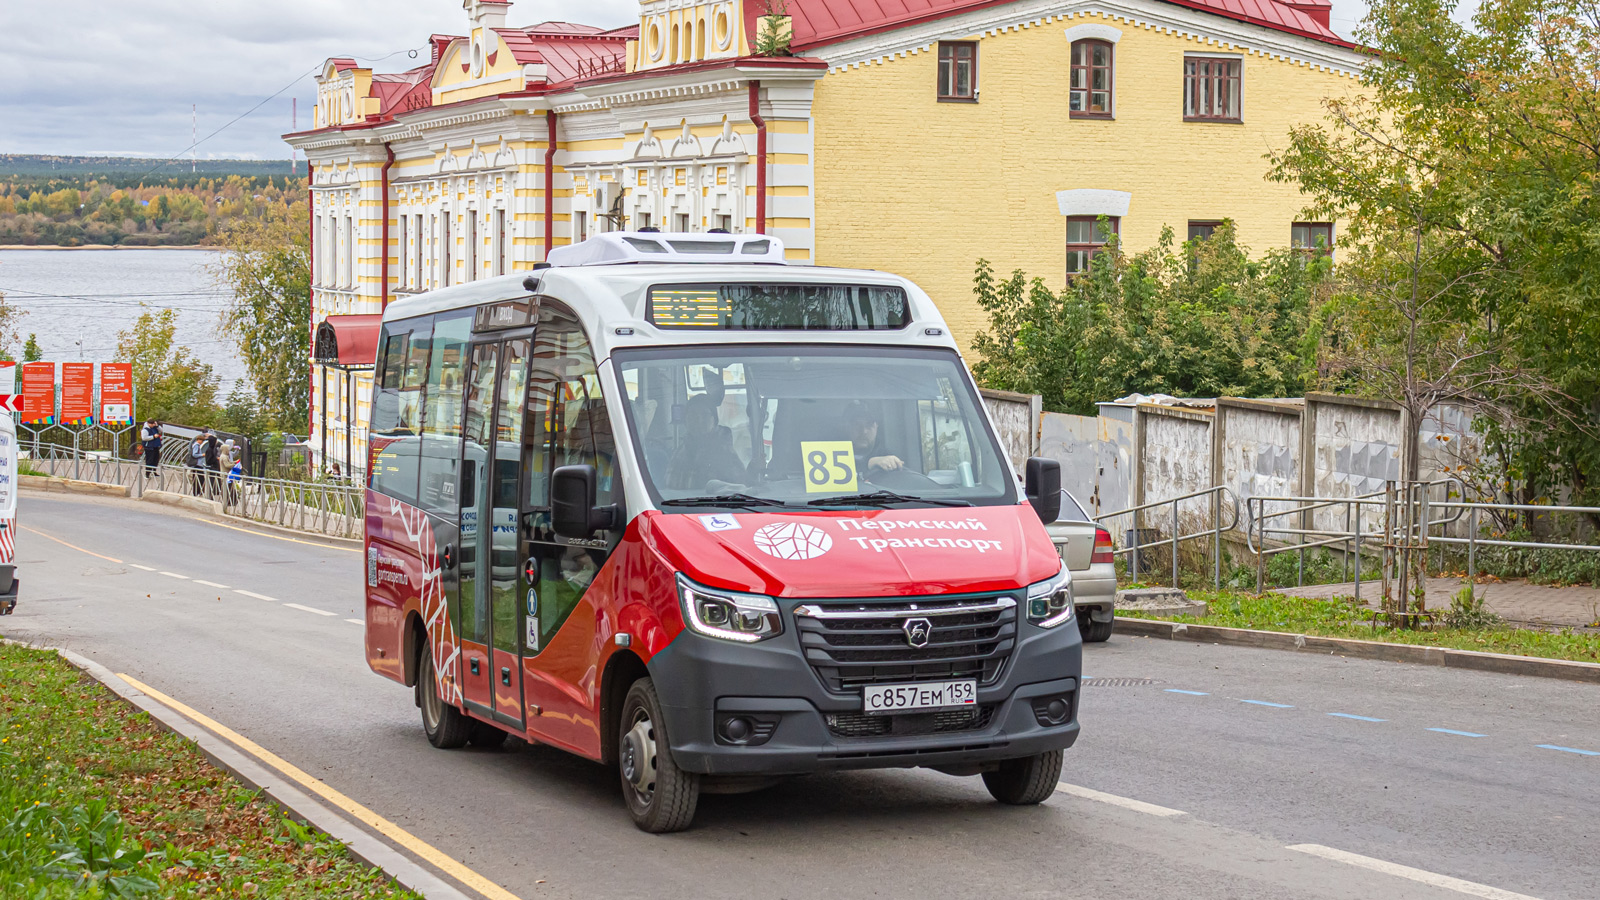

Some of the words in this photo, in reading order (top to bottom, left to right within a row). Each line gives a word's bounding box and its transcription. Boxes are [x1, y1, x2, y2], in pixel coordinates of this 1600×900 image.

[807, 450, 852, 485] 85
[836, 518, 988, 533] Пермский
[849, 537, 1003, 553] Транспорт
[946, 683, 972, 698] 159
